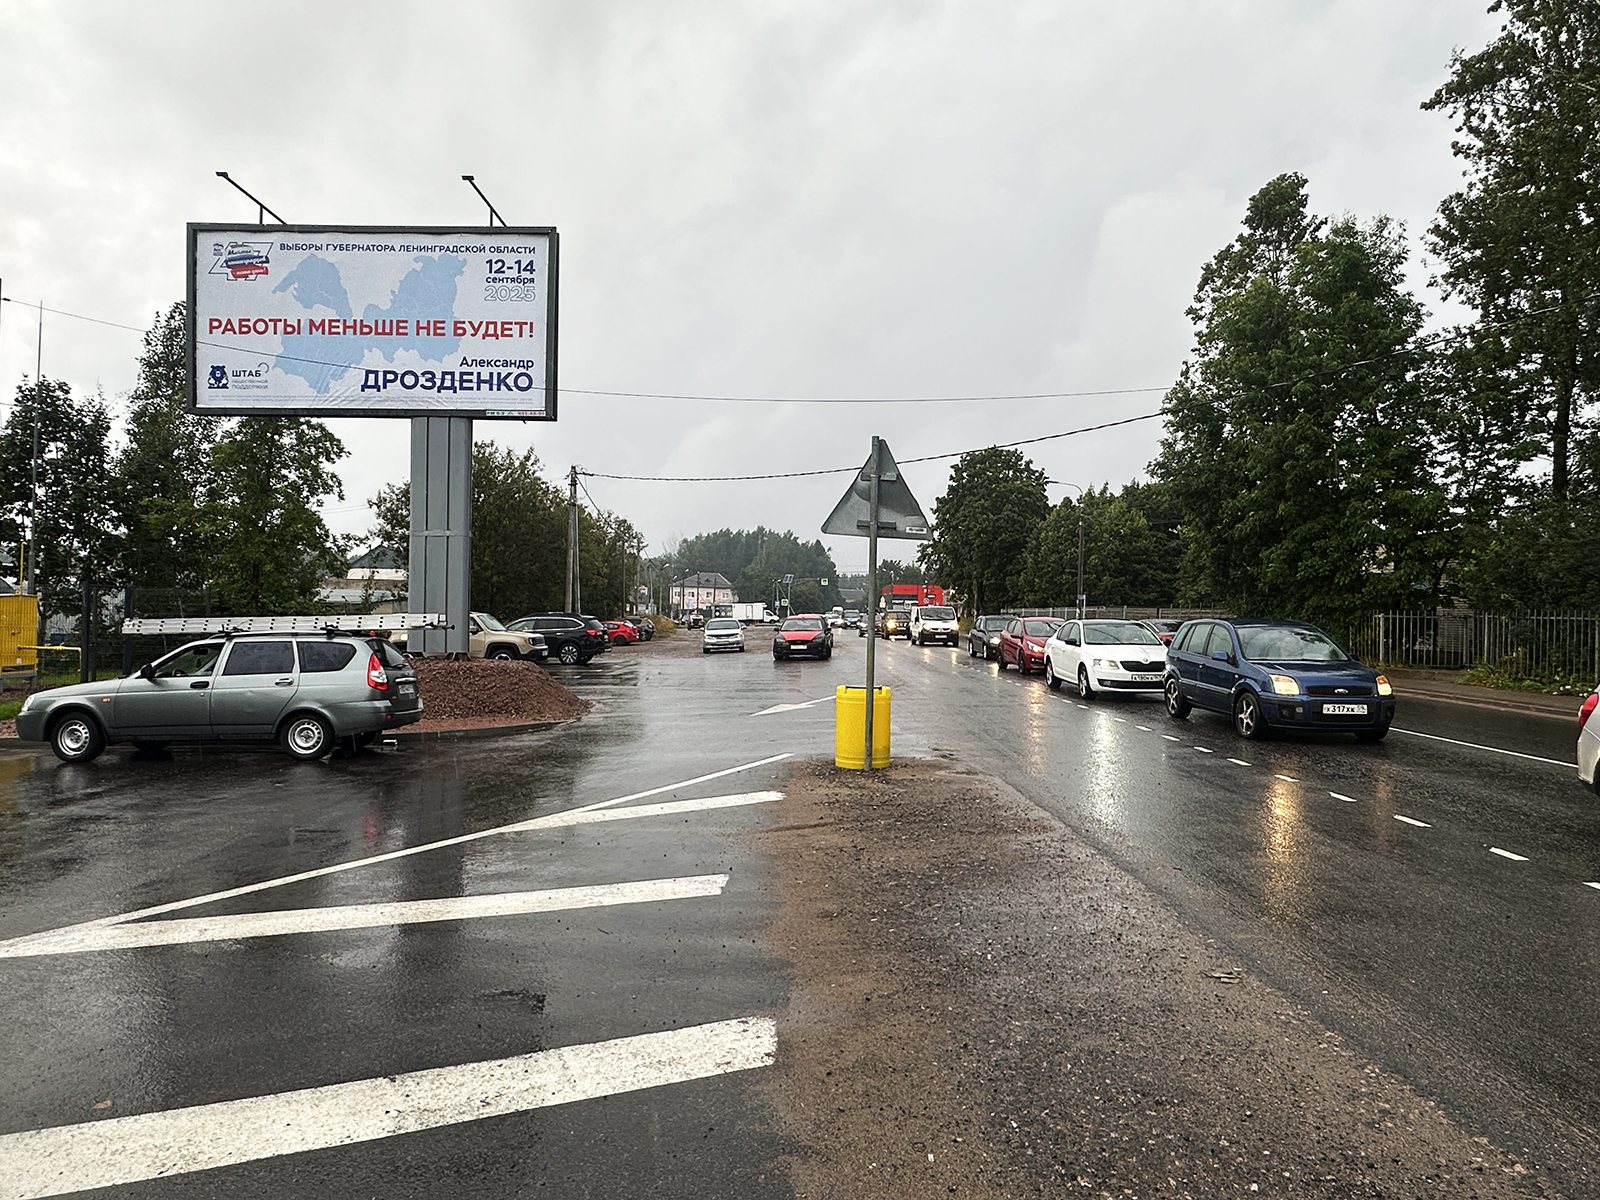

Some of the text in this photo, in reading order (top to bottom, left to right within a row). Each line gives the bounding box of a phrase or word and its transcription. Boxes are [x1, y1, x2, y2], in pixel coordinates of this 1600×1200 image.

[280, 243, 536, 254] ВЫБОРЫ ГУБЕРНАТОРА ЛЕНИНГРАДСКОЙ ОБЛАСТИ
[485, 259, 536, 275] 12-14
[485, 275, 535, 285] сентября
[484, 285, 536, 302] 2025
[208, 318, 534, 339] РАБОТЫ МЕНЬШЕ НЕ БУДЕТ!
[459, 356, 534, 371] Александр
[231, 369, 262, 378] ШТАБ
[361, 369, 534, 393] ДРОЗДЕНКО
